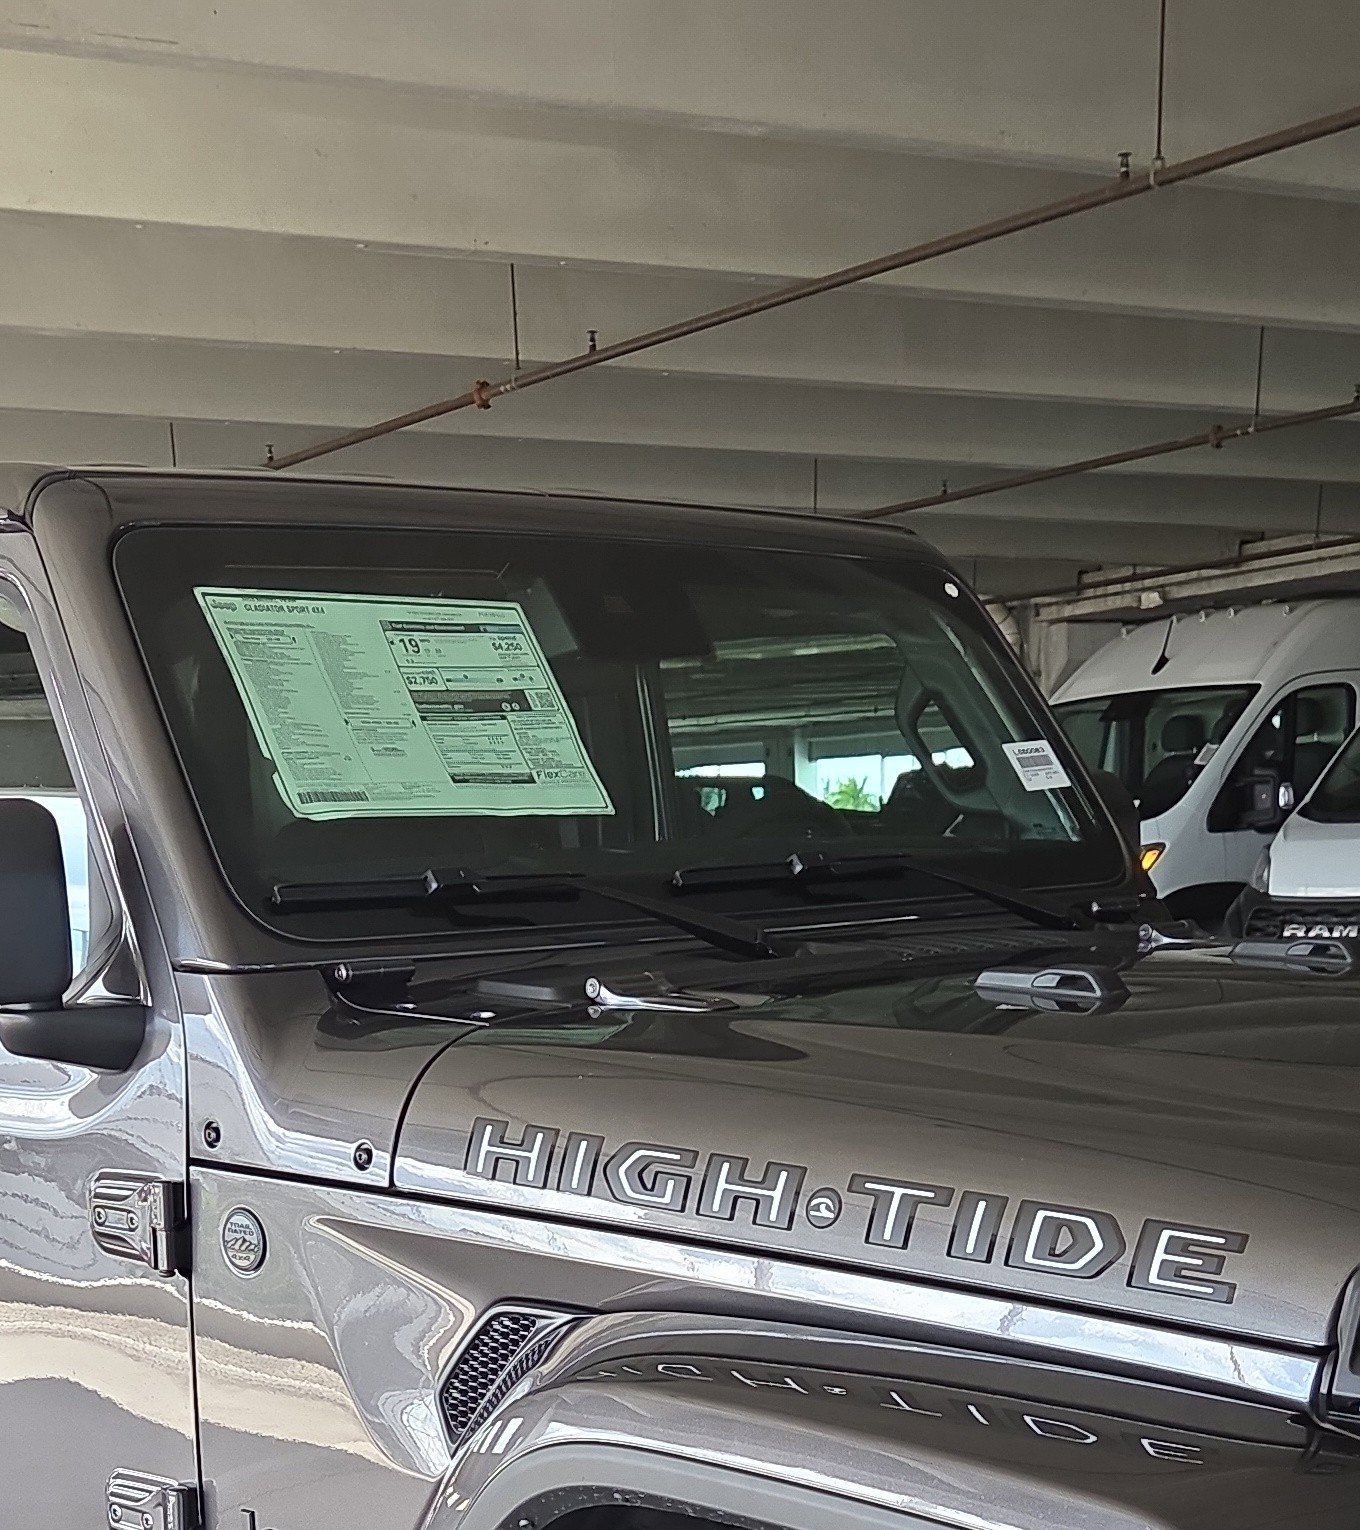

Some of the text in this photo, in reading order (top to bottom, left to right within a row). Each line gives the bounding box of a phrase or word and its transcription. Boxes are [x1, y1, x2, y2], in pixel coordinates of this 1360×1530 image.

[398, 637, 421, 654] 19
[1282, 923, 1359, 938] RAM
[463, 1115, 1250, 1305] HIGH TIDE
